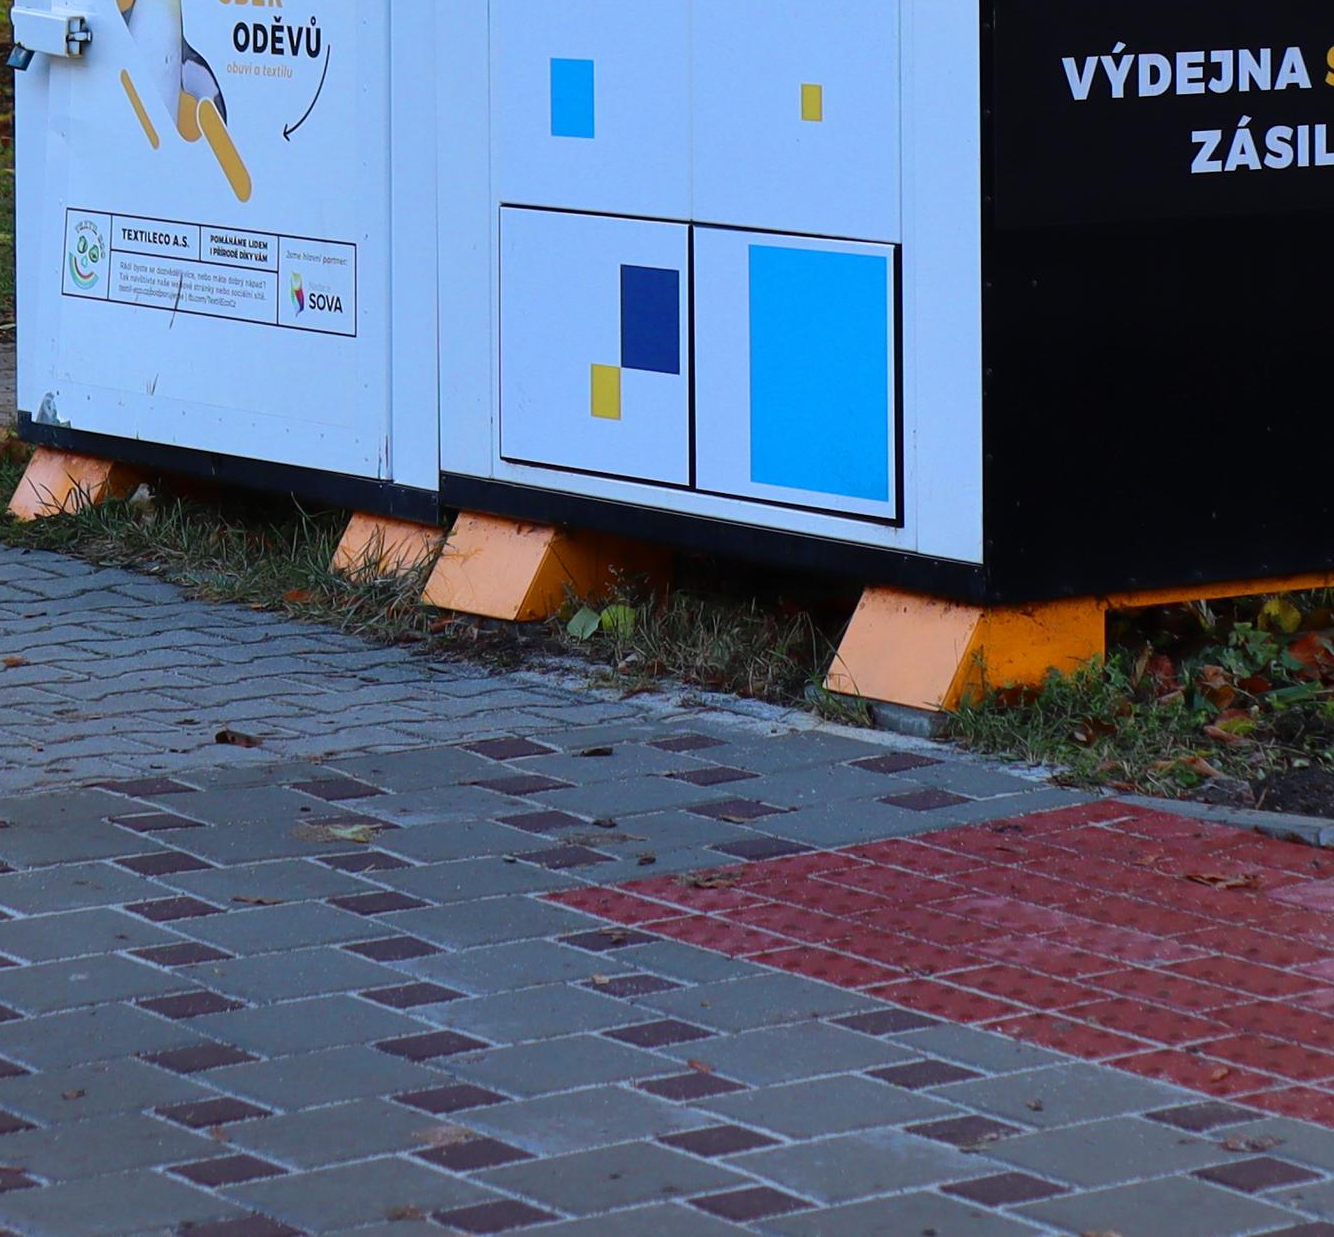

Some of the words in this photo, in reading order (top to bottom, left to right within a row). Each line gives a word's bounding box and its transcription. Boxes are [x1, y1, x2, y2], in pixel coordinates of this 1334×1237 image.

[233, 16, 322, 58] ODĚVŮ
[226, 61, 252, 75] obuvi
[254, 66, 260, 75] a
[262, 64, 293, 79] textilu
[1061, 41, 1313, 101] VÝDEJNA
[122, 228, 170, 246] TEXTILECO
[172, 234, 190, 248] A.S.
[248, 238, 268, 250] LIDEM
[253, 252, 268, 263] VÁM
[309, 293, 343, 313] SOVA
